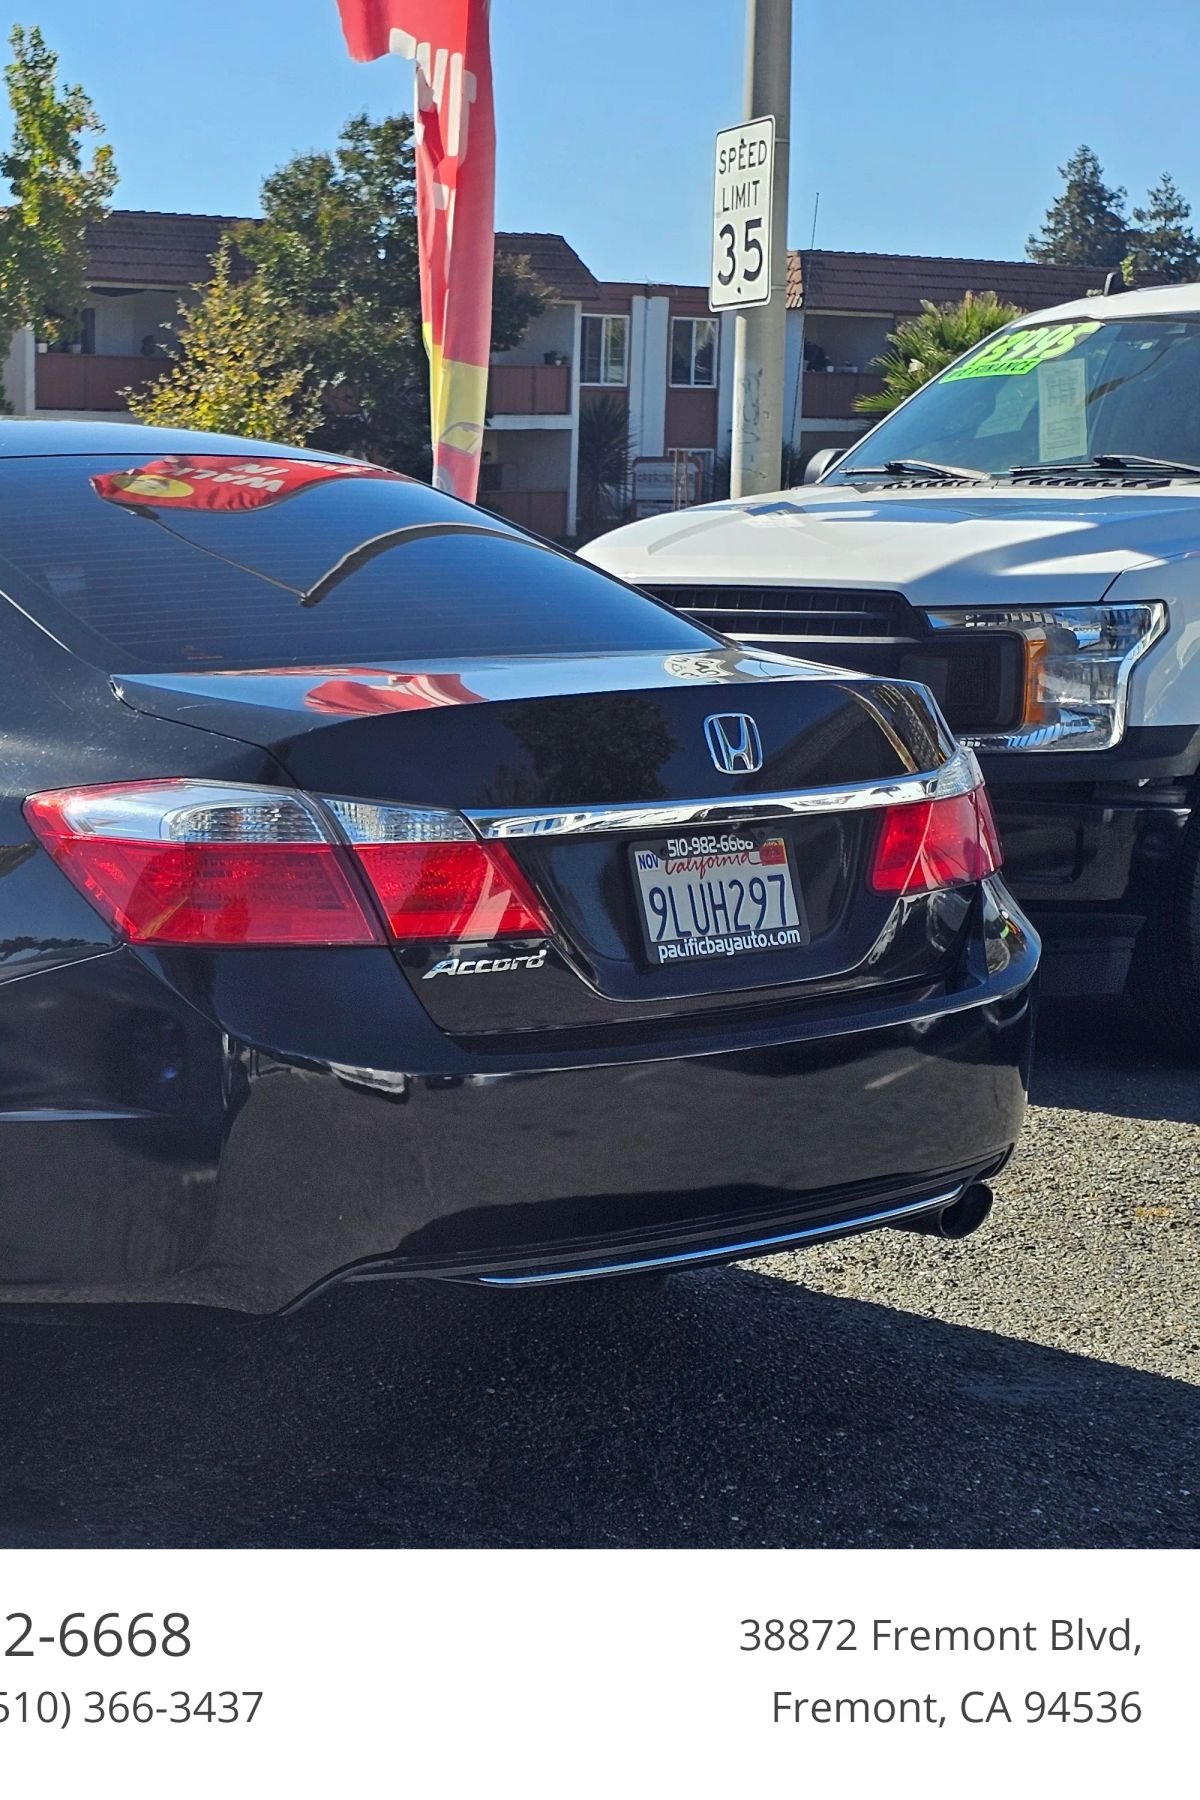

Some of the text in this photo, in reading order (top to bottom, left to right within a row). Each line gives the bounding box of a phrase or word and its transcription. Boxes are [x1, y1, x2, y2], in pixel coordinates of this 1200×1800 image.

[718, 139, 768, 175] SPEED
[722, 180, 761, 213] LIMIT
[717, 217, 763, 287] 35
[637, 853, 659, 870] NOV
[664, 852, 757, 879] California
[648, 874, 787, 941] 9LUH297
[657, 929, 801, 963] pacificbayauto.com
[421, 949, 548, 980] Accord
